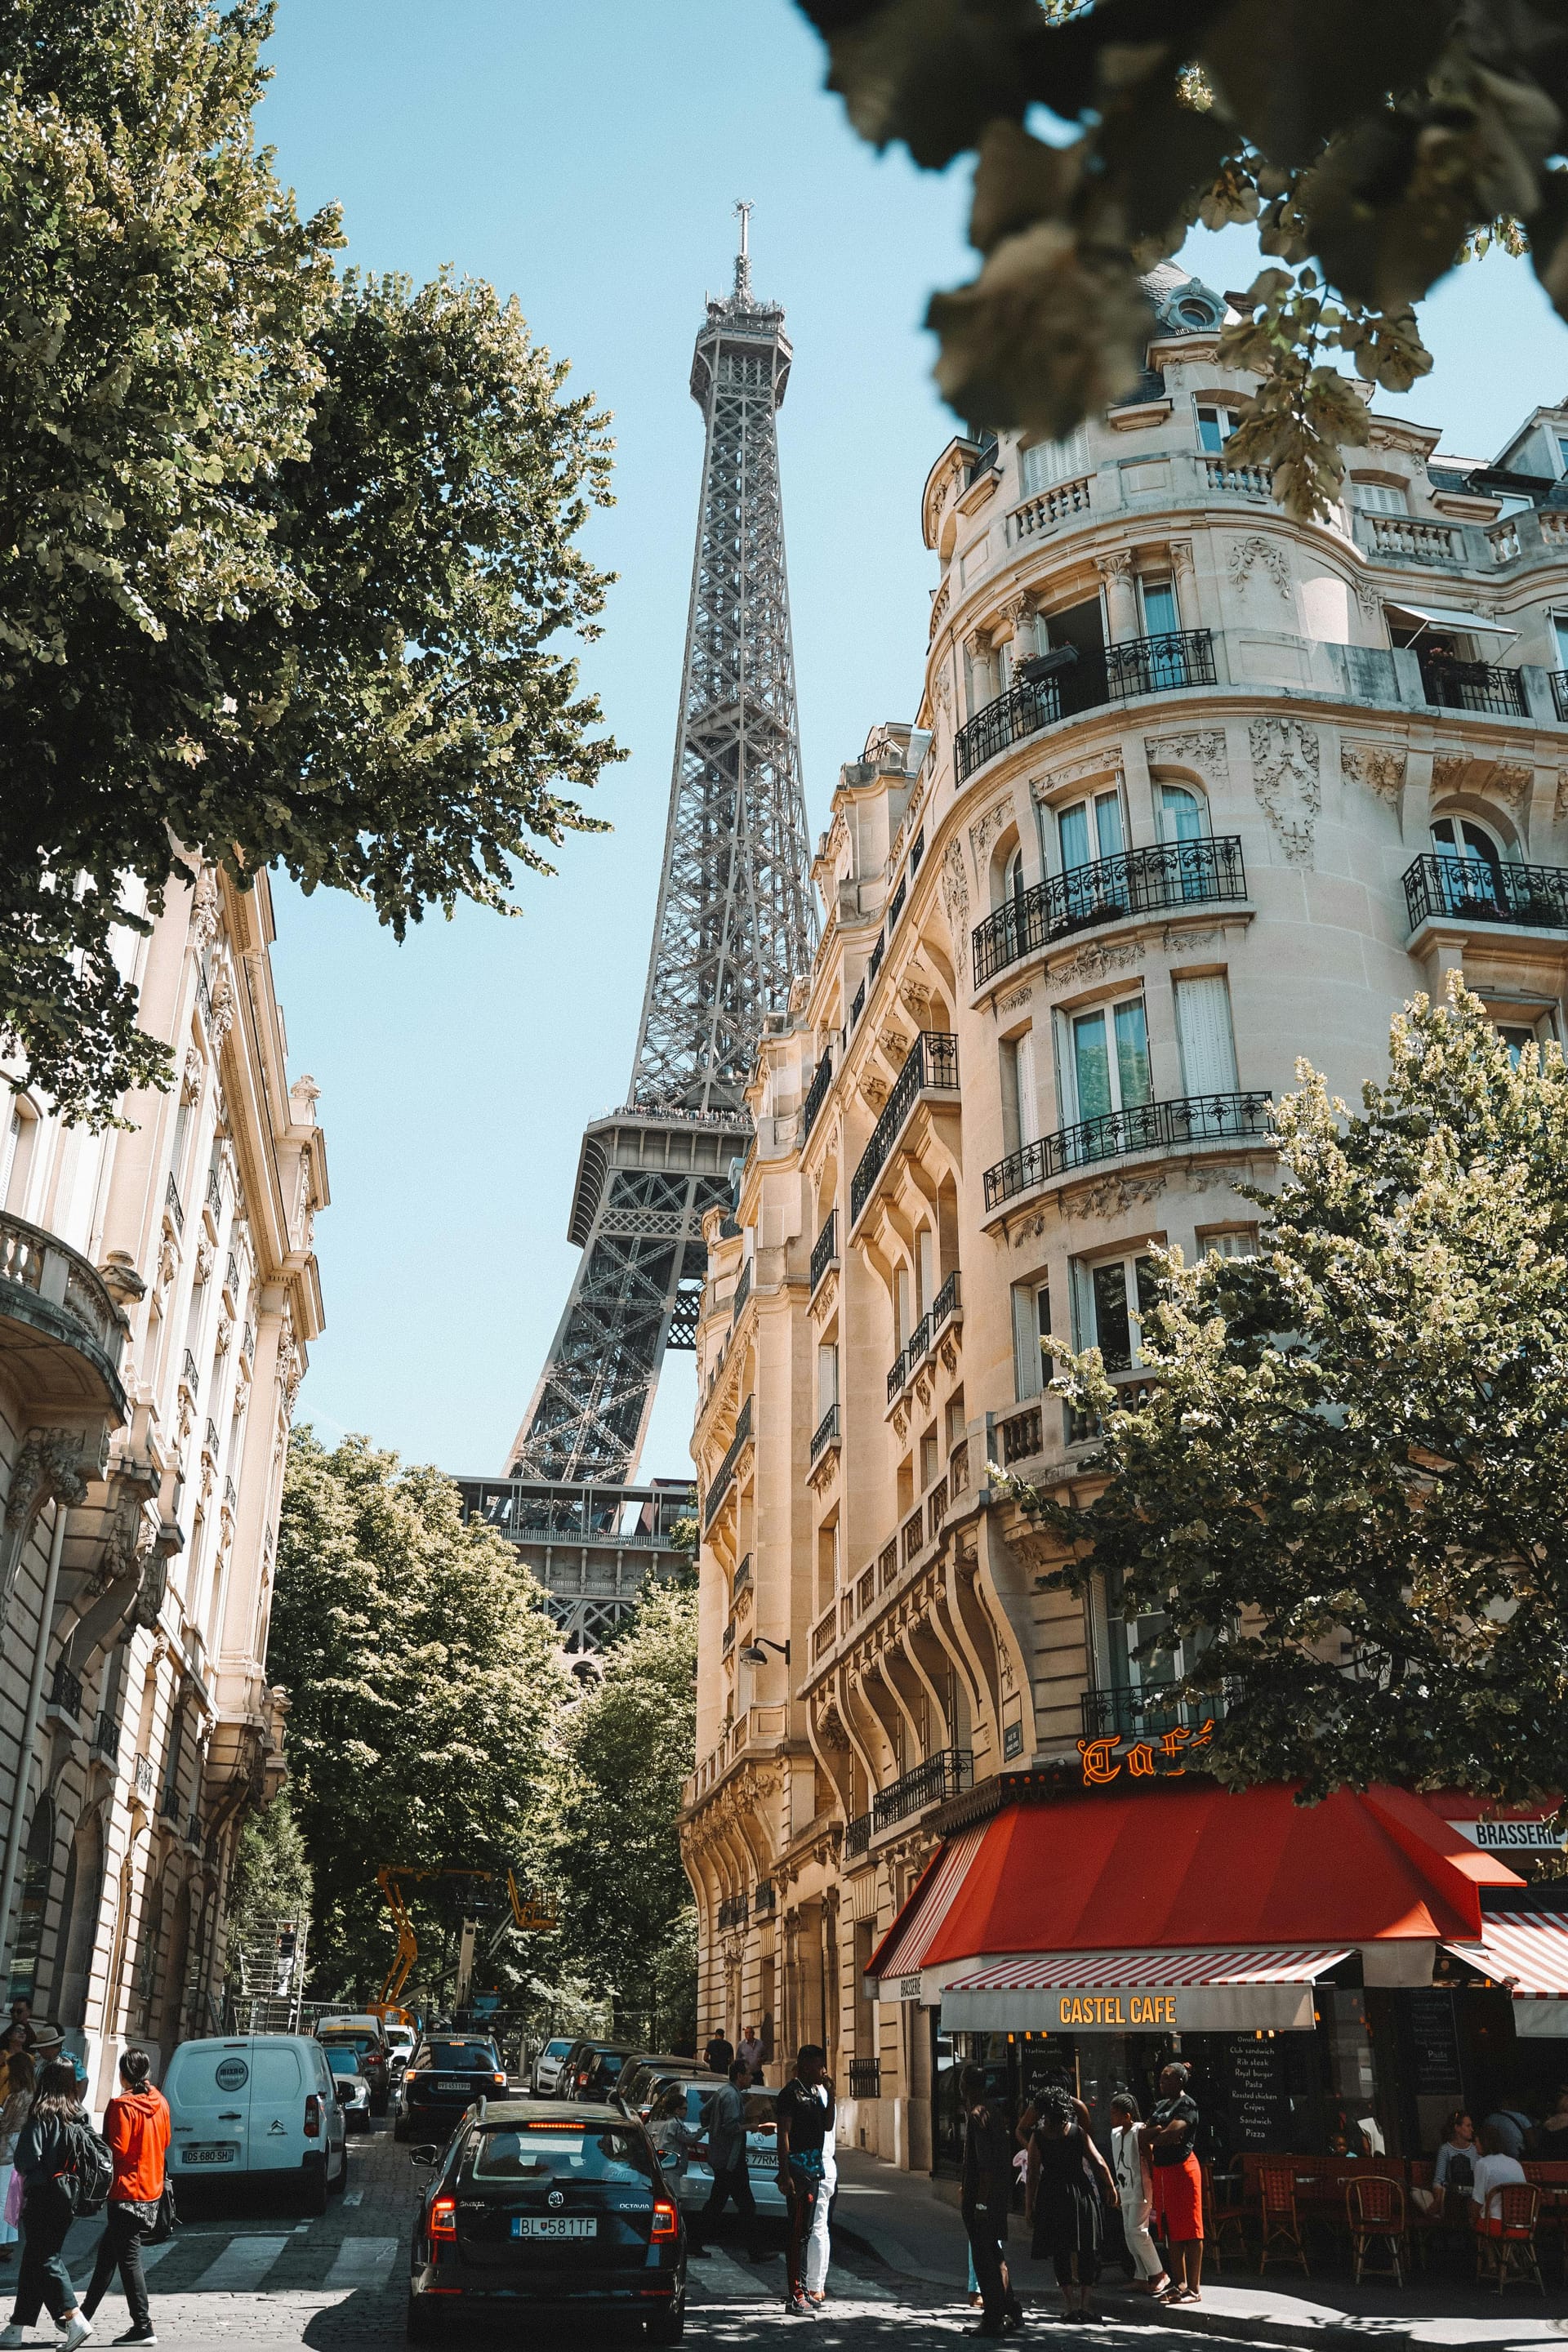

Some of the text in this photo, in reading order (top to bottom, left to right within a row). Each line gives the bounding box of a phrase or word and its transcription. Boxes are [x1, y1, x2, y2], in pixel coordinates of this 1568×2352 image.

[1060, 1996, 1177, 2024] CASTEL CAFE
[1253, 2069, 1273, 2078] burger
[1245, 2080, 1263, 2088] Pasta
[1232, 2091, 1254, 2099] Roasted
[1240, 2116, 1272, 2125] Sandwich
[1245, 2128, 1266, 2138] Pizza
[521, 2219, 595, 2235] BL 581TF
